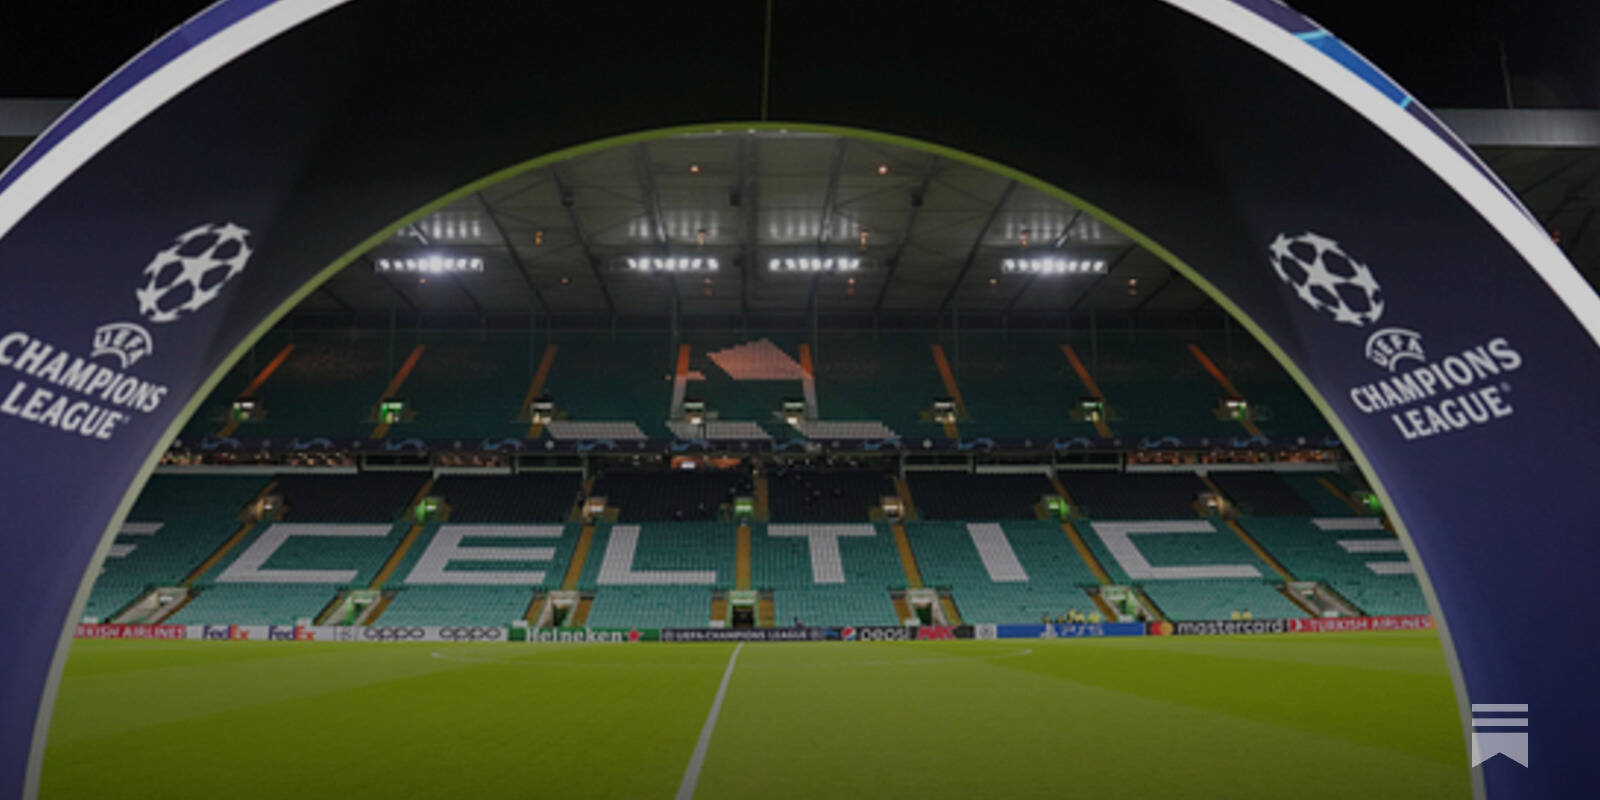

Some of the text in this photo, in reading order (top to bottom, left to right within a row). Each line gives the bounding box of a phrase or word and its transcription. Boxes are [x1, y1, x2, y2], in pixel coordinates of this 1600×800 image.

[94, 326, 146, 366] UEFA
[1370, 331, 1425, 367] UEFA
[0, 331, 167, 413] CHAMPIONS
[1350, 337, 1522, 414] CHAMPIONS
[0, 381, 124, 440] LEAGUE
[1392, 385, 1513, 440] LEAGUE
[122, 626, 184, 638] AIRLINES
[203, 625, 249, 640] FedEx
[269, 625, 316, 640] FedEx
[526, 626, 622, 642] Heineken
[1178, 620, 1284, 635] mastercard
[1310, 617, 1431, 631] TURKISH AIRLINES
